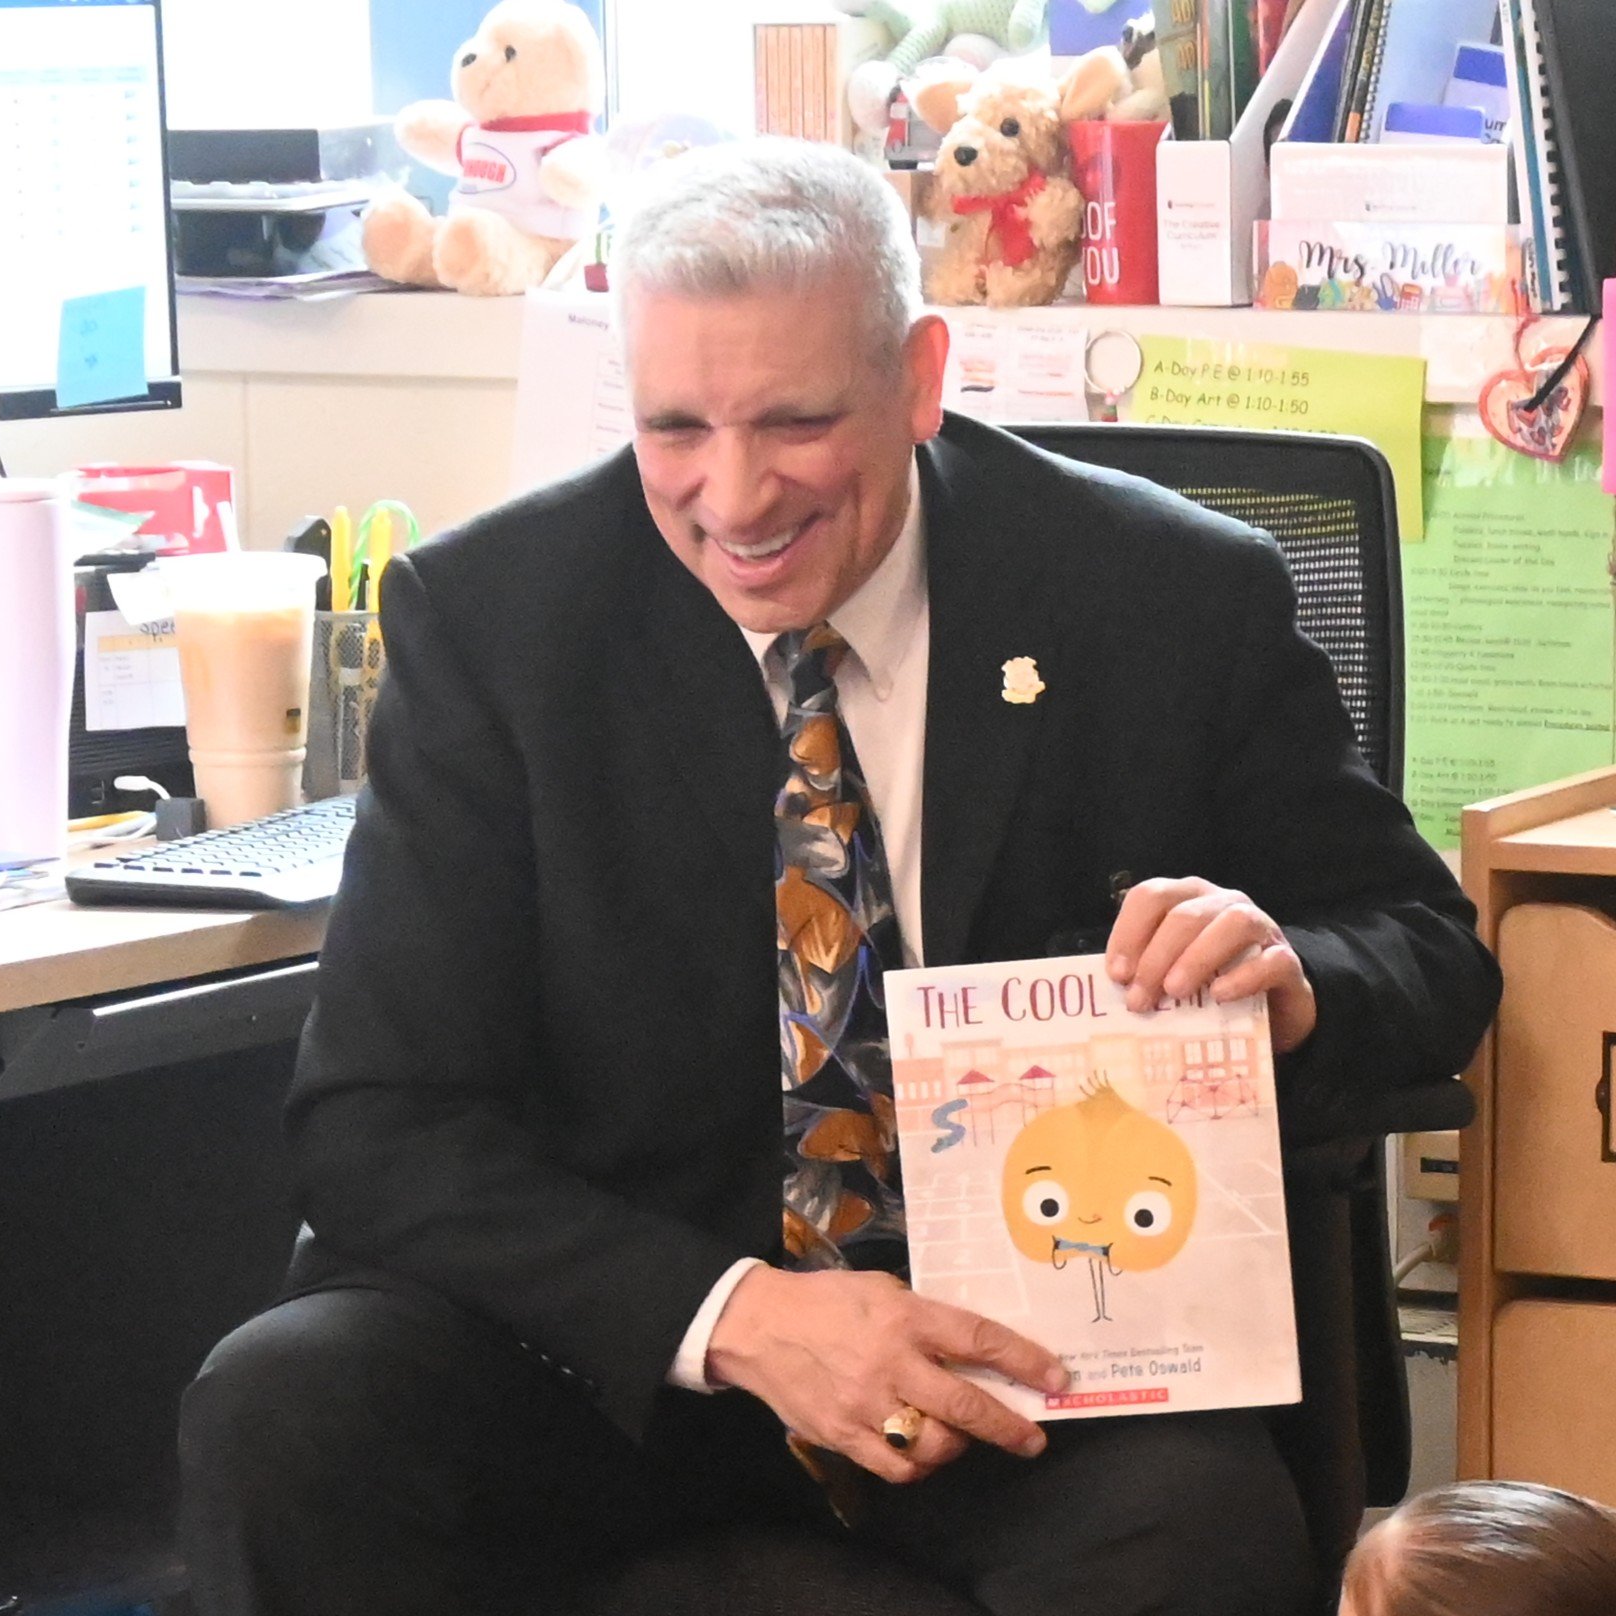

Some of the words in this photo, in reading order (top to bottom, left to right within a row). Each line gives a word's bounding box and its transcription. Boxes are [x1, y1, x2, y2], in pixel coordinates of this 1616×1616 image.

[1381, 241, 1482, 281] Miller
[1149, 386, 1192, 405] B-Day
[1196, 391, 1222, 407] Art
[1226, 392, 1241, 410] @
[916, 985, 983, 1029] THE
[1000, 973, 1108, 1022] COOL
[1111, 1362, 1144, 1379] Pete
[1148, 1357, 1202, 1377] Oswald
